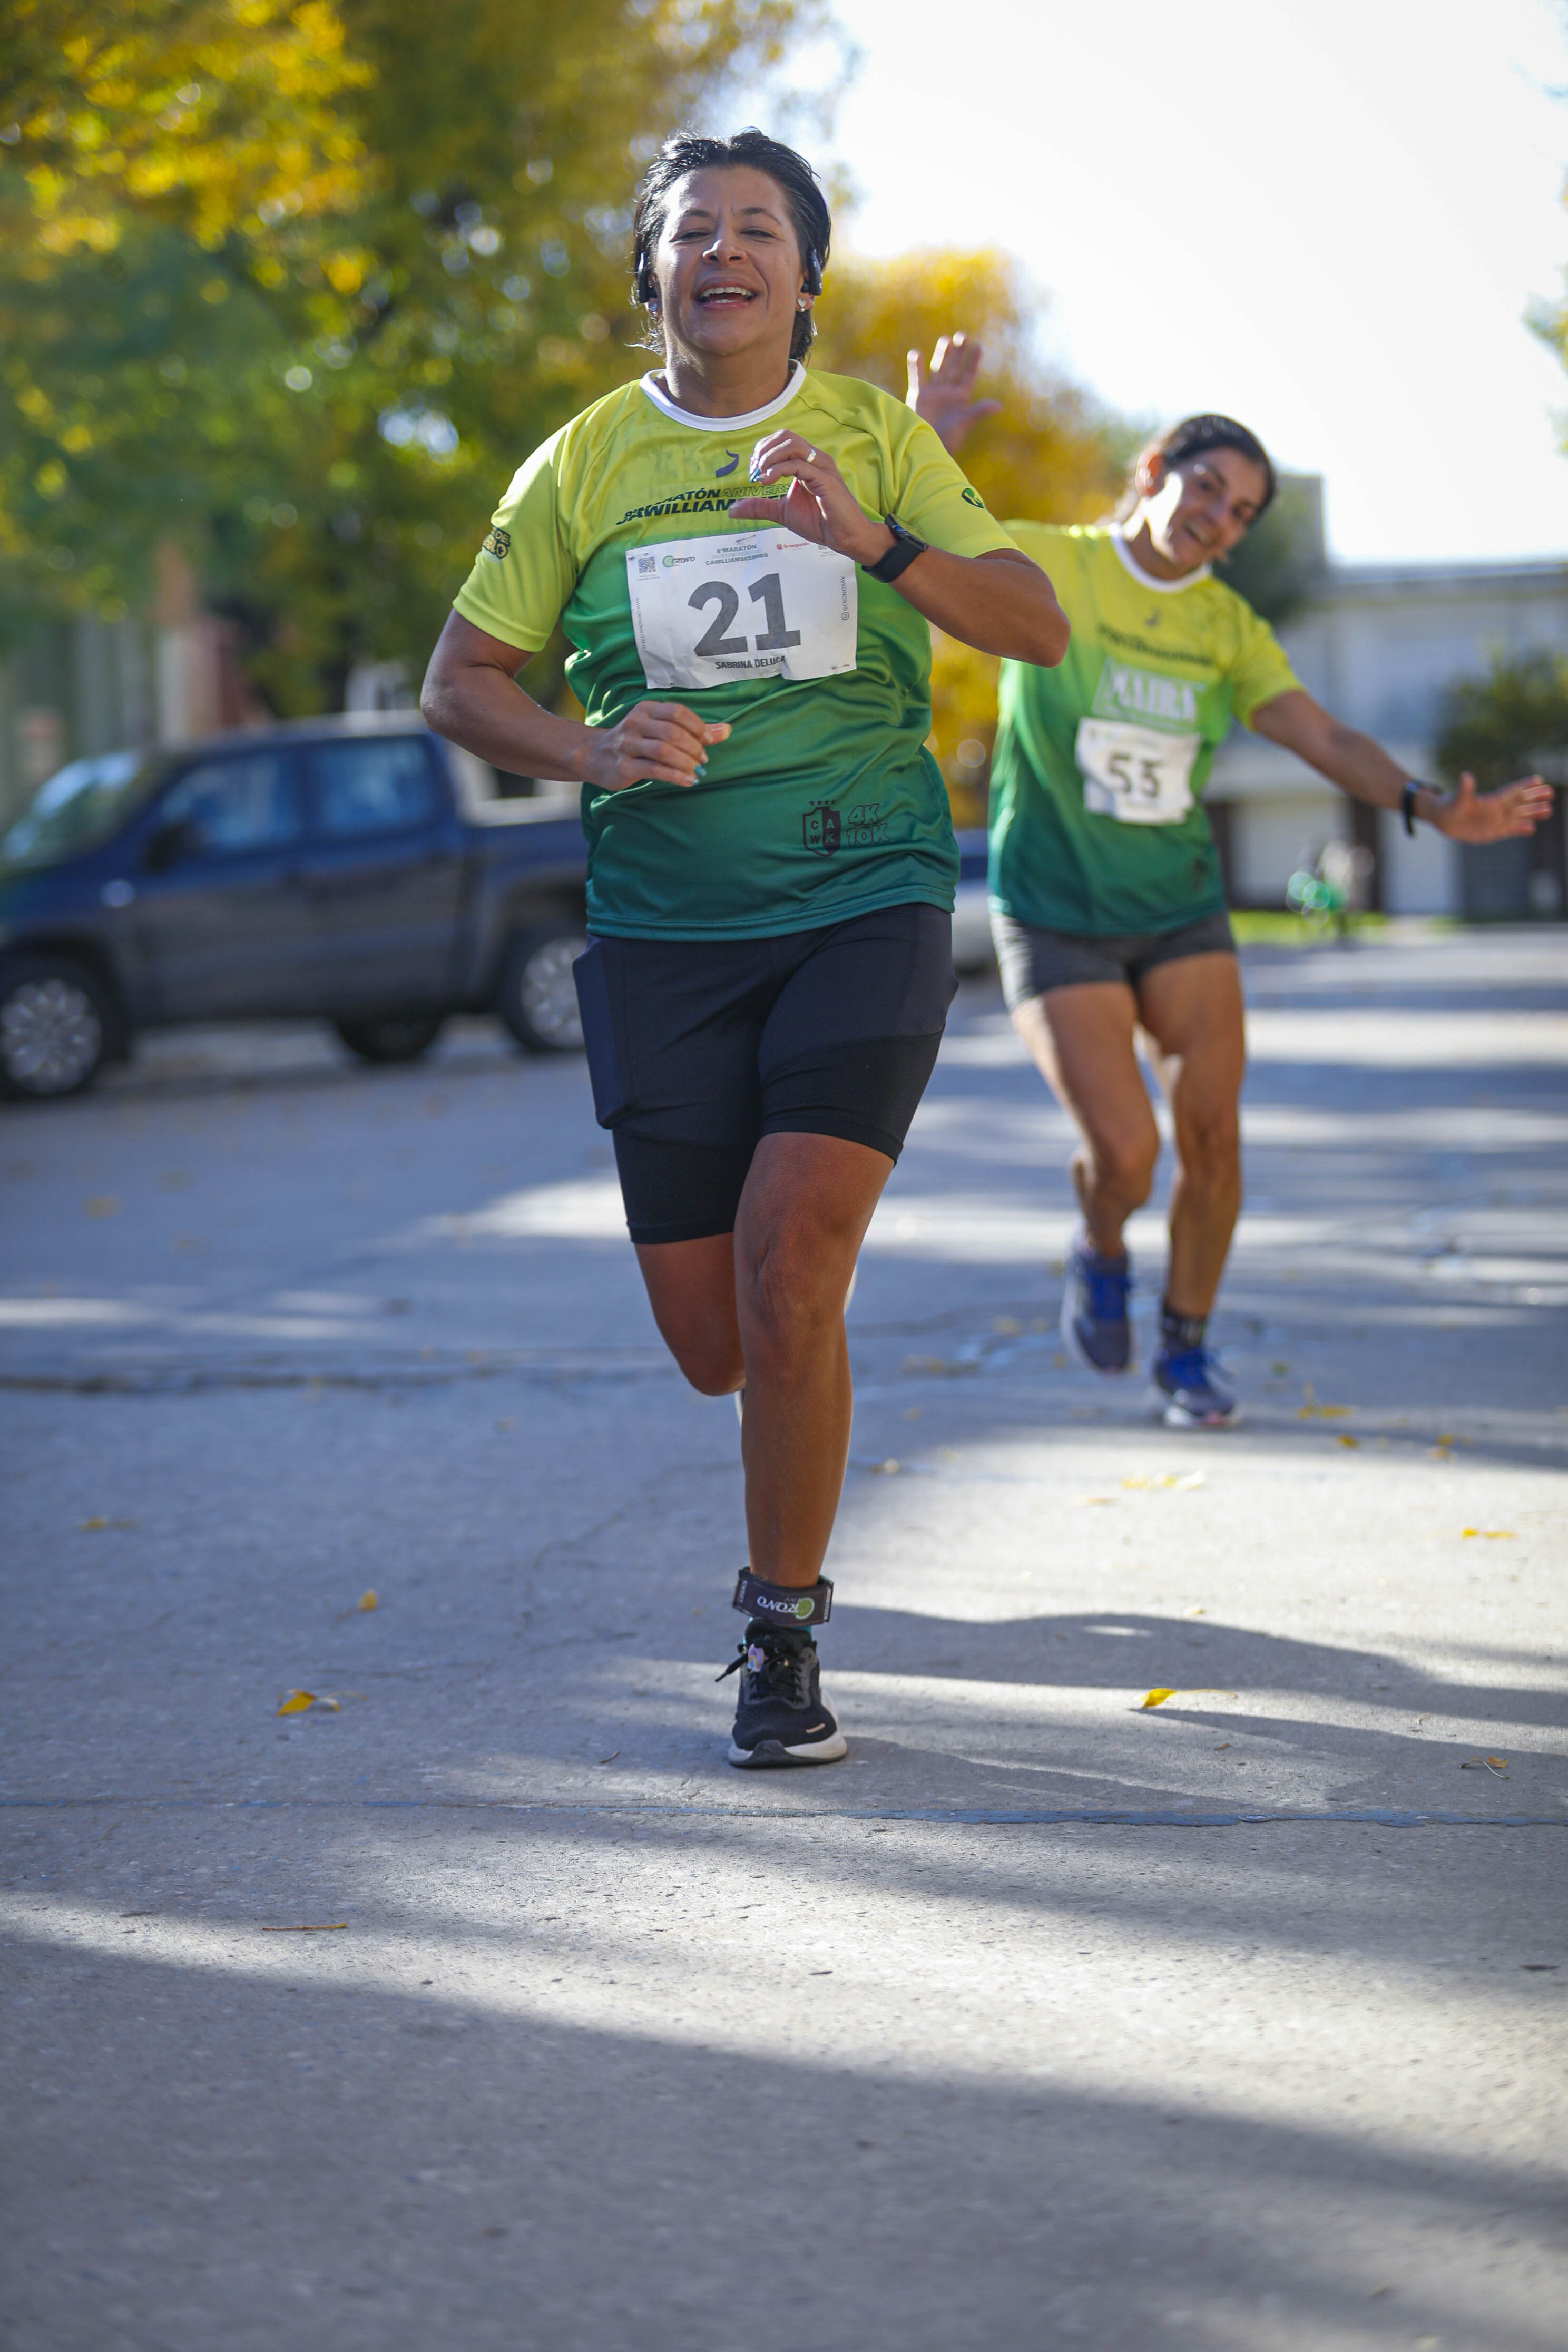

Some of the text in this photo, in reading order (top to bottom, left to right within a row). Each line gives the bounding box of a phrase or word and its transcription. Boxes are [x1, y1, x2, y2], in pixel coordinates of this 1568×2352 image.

[688, 573, 801, 657] 21
[715, 655, 786, 669] SABRINA DELUCA
[847, 803, 879, 825] 4K
[846, 822, 890, 847] 10K
